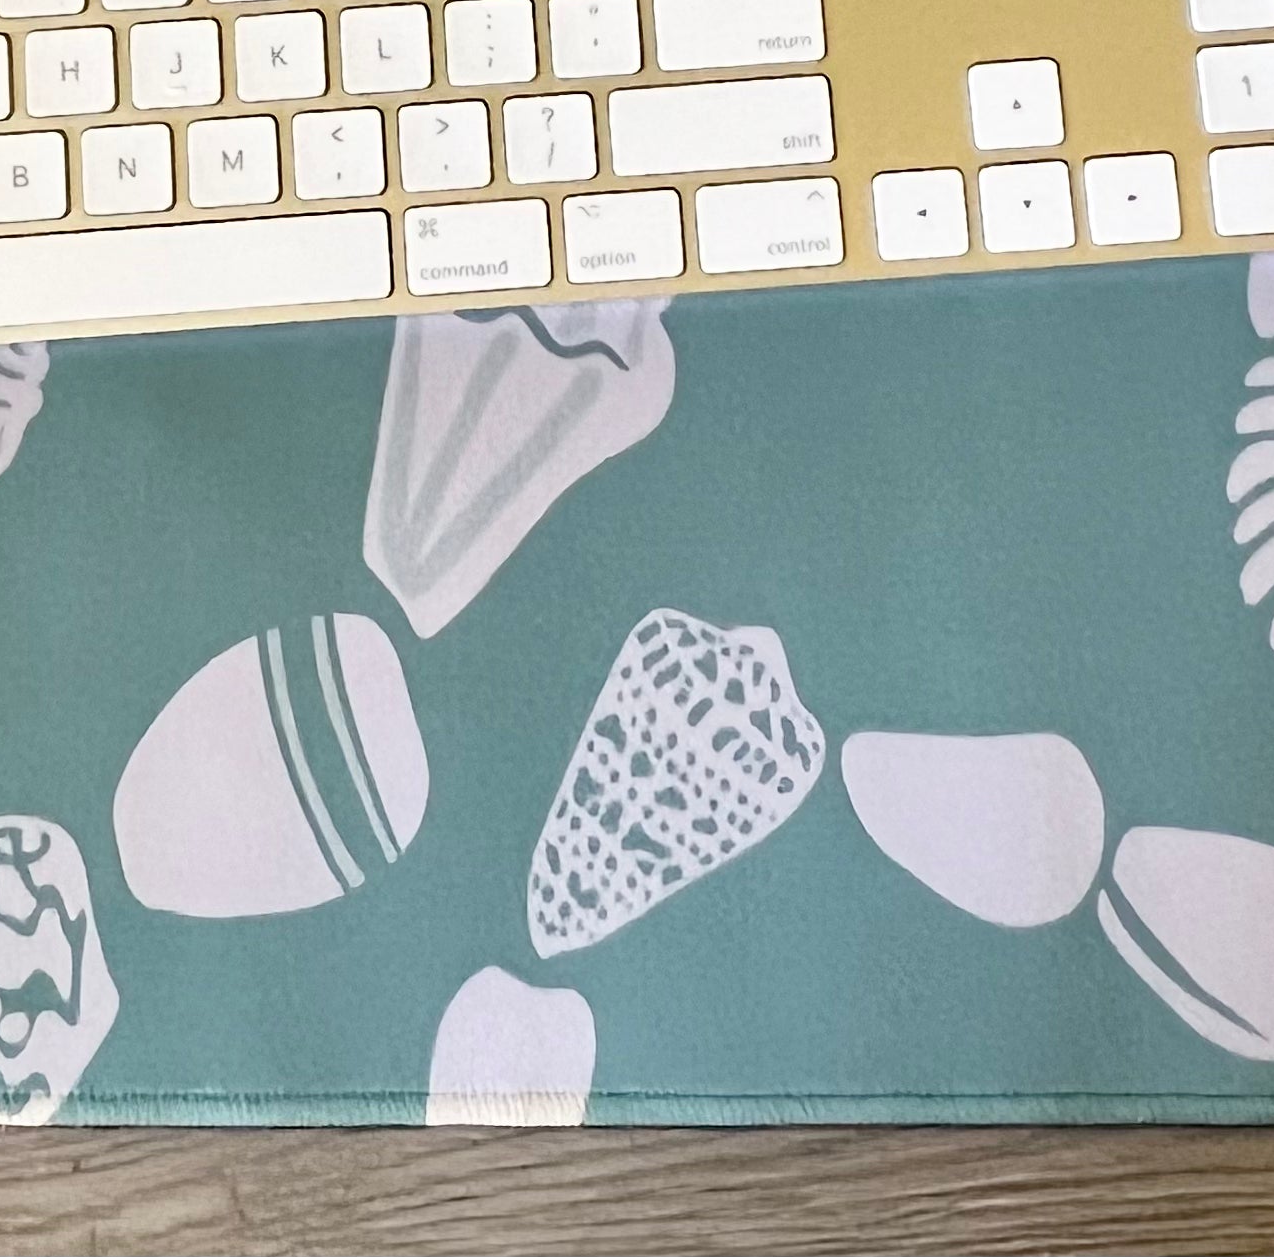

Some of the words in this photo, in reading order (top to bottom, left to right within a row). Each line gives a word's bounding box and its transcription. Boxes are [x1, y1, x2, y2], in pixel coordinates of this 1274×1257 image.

[270, 44, 288, 68] K
[377, 37, 392, 61] L
[60, 60, 80, 82] H
[169, 51, 183, 75] J
[1241, 74, 1253, 98] 1
[541, 106, 555, 132] ?
[118, 157, 137, 181] N
[221, 149, 244, 173] M
[12, 164, 30, 189] B
[766, 236, 831, 256] control
[419, 259, 509, 281] command
[579, 251, 637, 270] option
